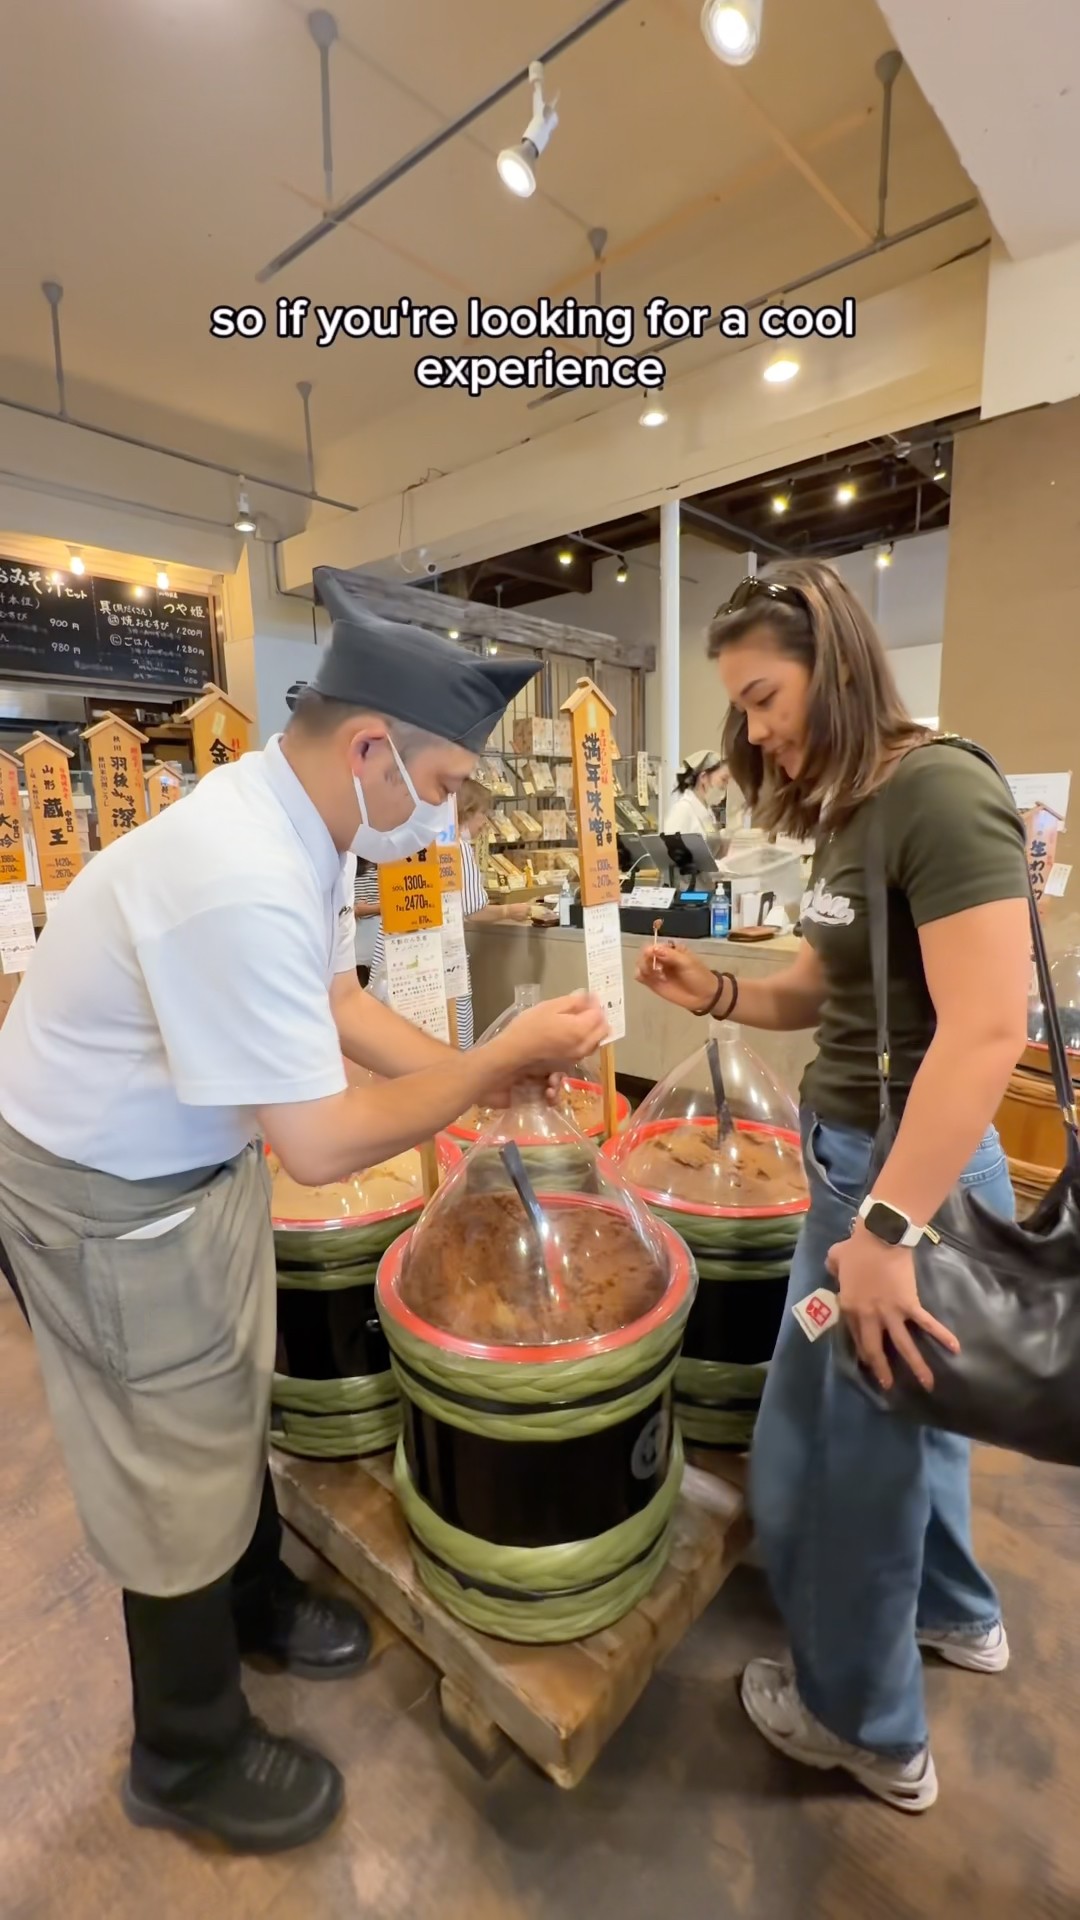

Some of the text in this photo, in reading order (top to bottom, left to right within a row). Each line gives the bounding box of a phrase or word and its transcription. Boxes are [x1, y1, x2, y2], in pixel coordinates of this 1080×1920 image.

[163, 603, 206, 619] つや姫
[43, 798, 69, 846] 蔵王
